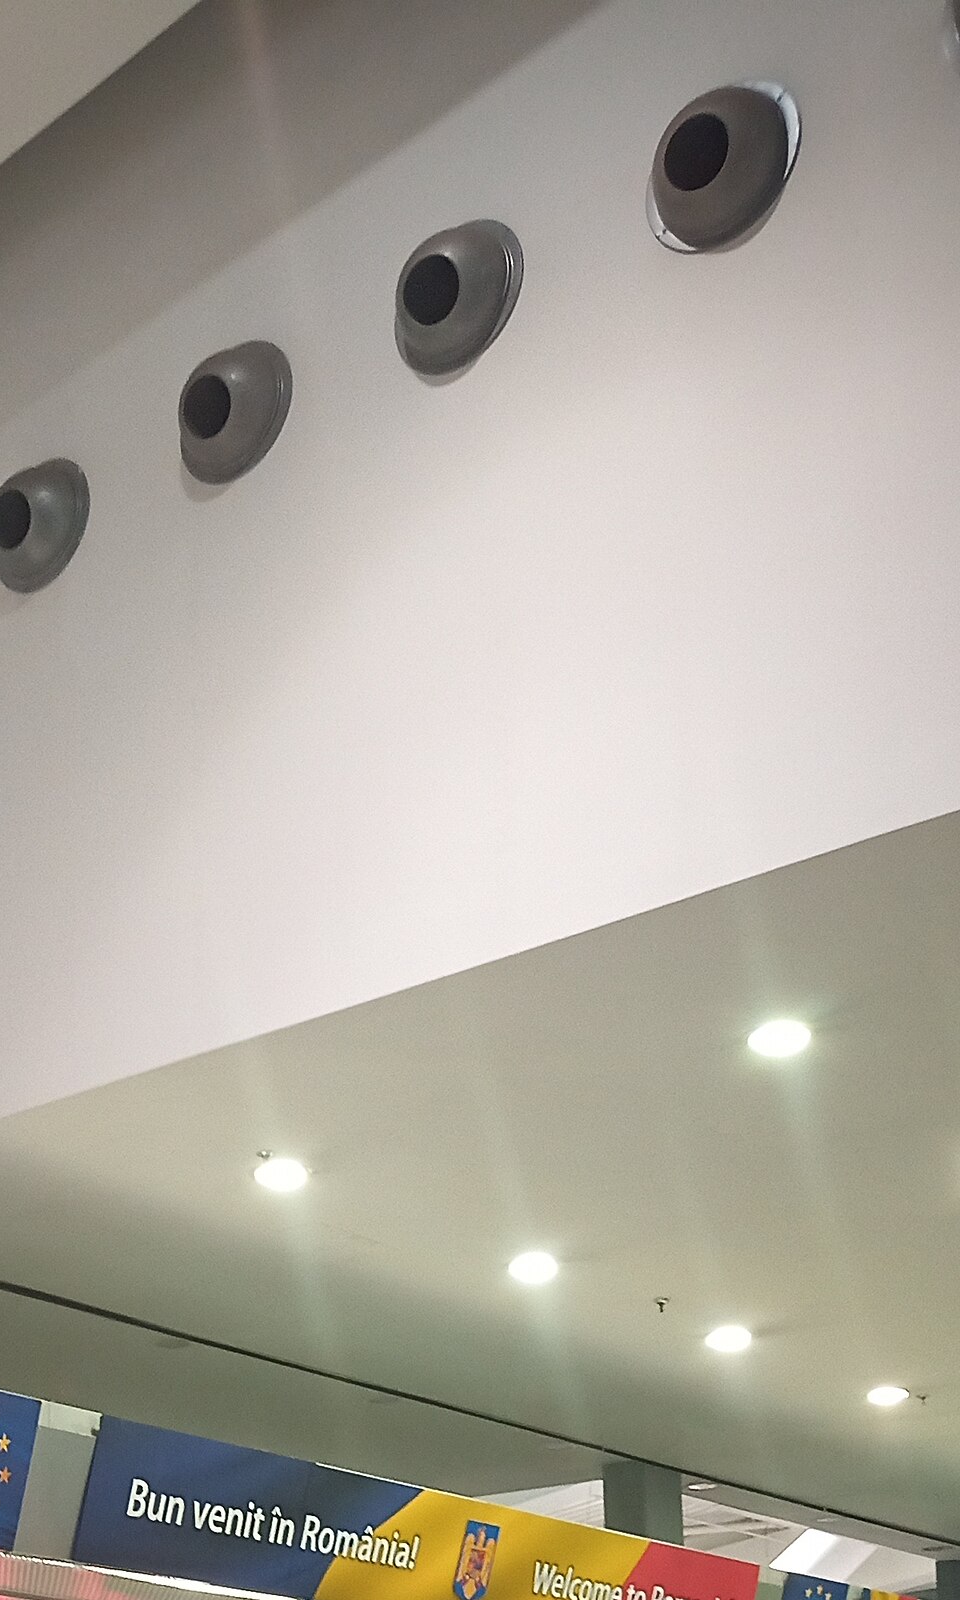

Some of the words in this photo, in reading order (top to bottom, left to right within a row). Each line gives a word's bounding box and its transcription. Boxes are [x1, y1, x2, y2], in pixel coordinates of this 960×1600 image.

[127, 1479, 185, 1525] Bun
[194, 1501, 265, 1541] venit
[269, 1507, 295, 1547] în
[300, 1515, 421, 1569] România!
